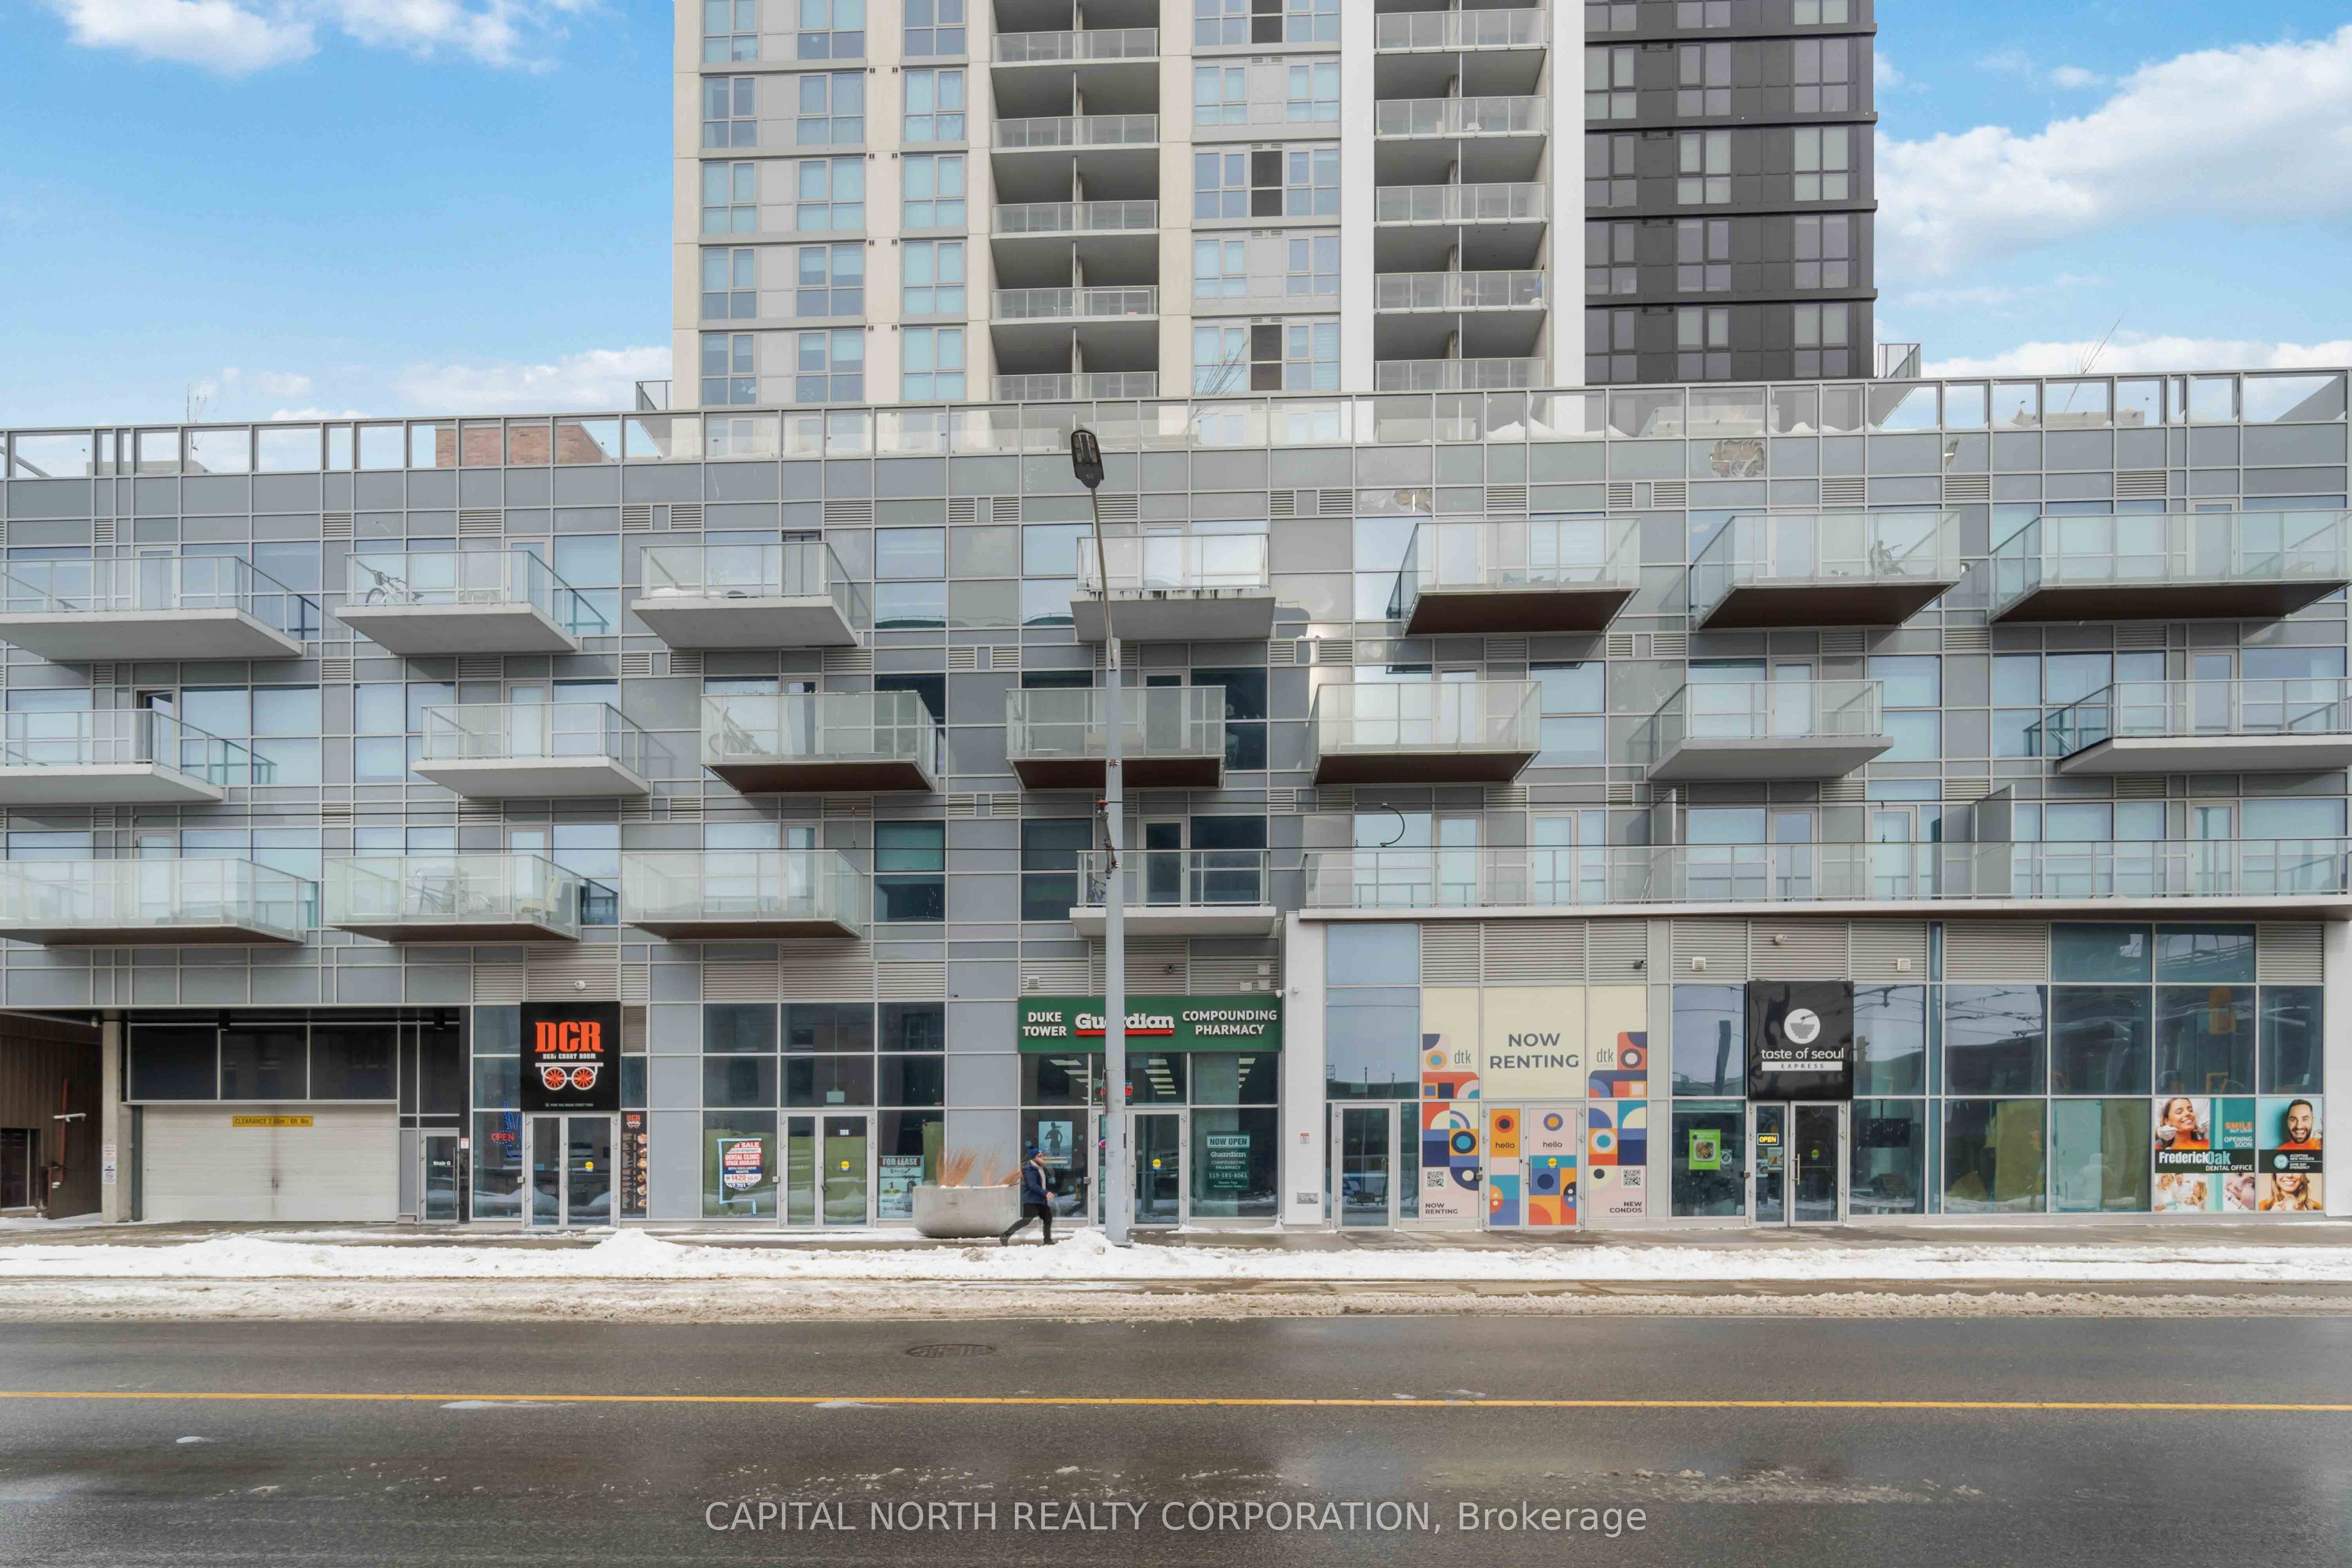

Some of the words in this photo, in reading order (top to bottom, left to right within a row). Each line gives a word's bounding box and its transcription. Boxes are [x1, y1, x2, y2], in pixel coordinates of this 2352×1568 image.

[1028, 1011, 1062, 1022] DUKE
[1075, 1012, 1175, 1030] Gudian
[1182, 1010, 1277, 1021] COMPOUNDING
[1022, 1025, 1067, 1037] TOWER
[1195, 1024, 1265, 1035] PHARMACY
[535, 1021, 604, 1052] DCR
[1508, 1033, 1561, 1047] NOW
[1454, 1049, 1471, 1064] dtk
[1597, 1048, 1613, 1063] dtk
[1761, 1049, 1793, 1059] taste
[1795, 1047, 1809, 1059] of
[1811, 1047, 1844, 1059] seoul
[1490, 1054, 1579, 1069] RENTING
[883, 1158, 897, 1166] FOR
[897, 1158, 918, 1166] LEASE
